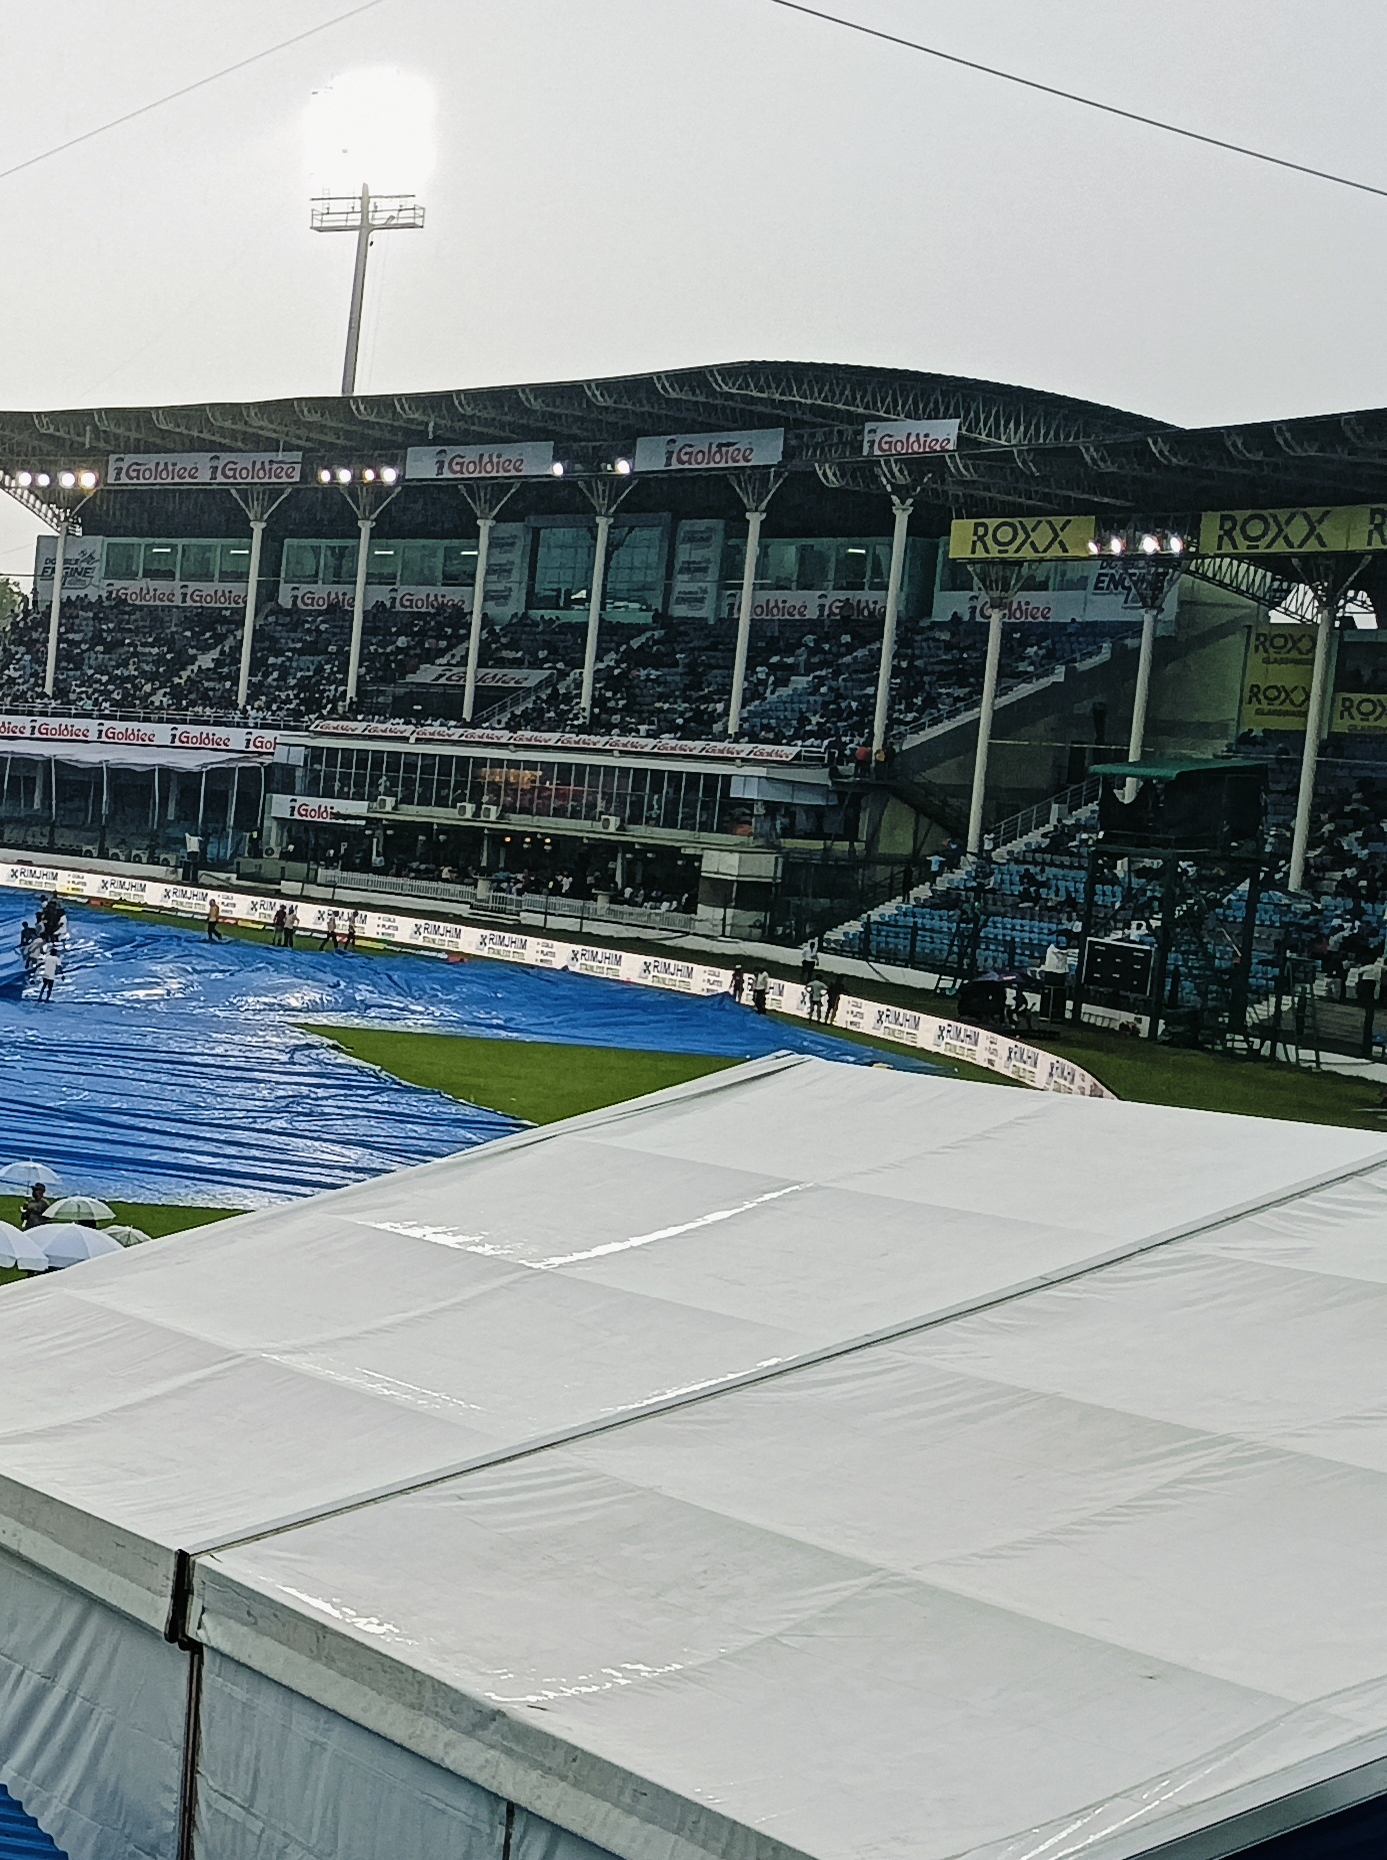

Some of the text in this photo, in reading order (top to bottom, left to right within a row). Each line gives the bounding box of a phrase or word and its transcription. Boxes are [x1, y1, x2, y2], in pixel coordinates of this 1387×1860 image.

[971, 519, 1072, 555] ROXX
[1217, 510, 1331, 551] ROXX
[301, 591, 356, 609] Goldie
[979, 600, 1052, 621] Gldiee
[1340, 697, 1387, 721] ROX
[19, 868, 58, 881] RIMJHIM
[172, 887, 208, 902] RIMJHIM
[580, 948, 622, 967] RIMJHIM
[653, 960, 693, 979] RIMJHIM
[885, 1008, 920, 1031] RIMJHIM
